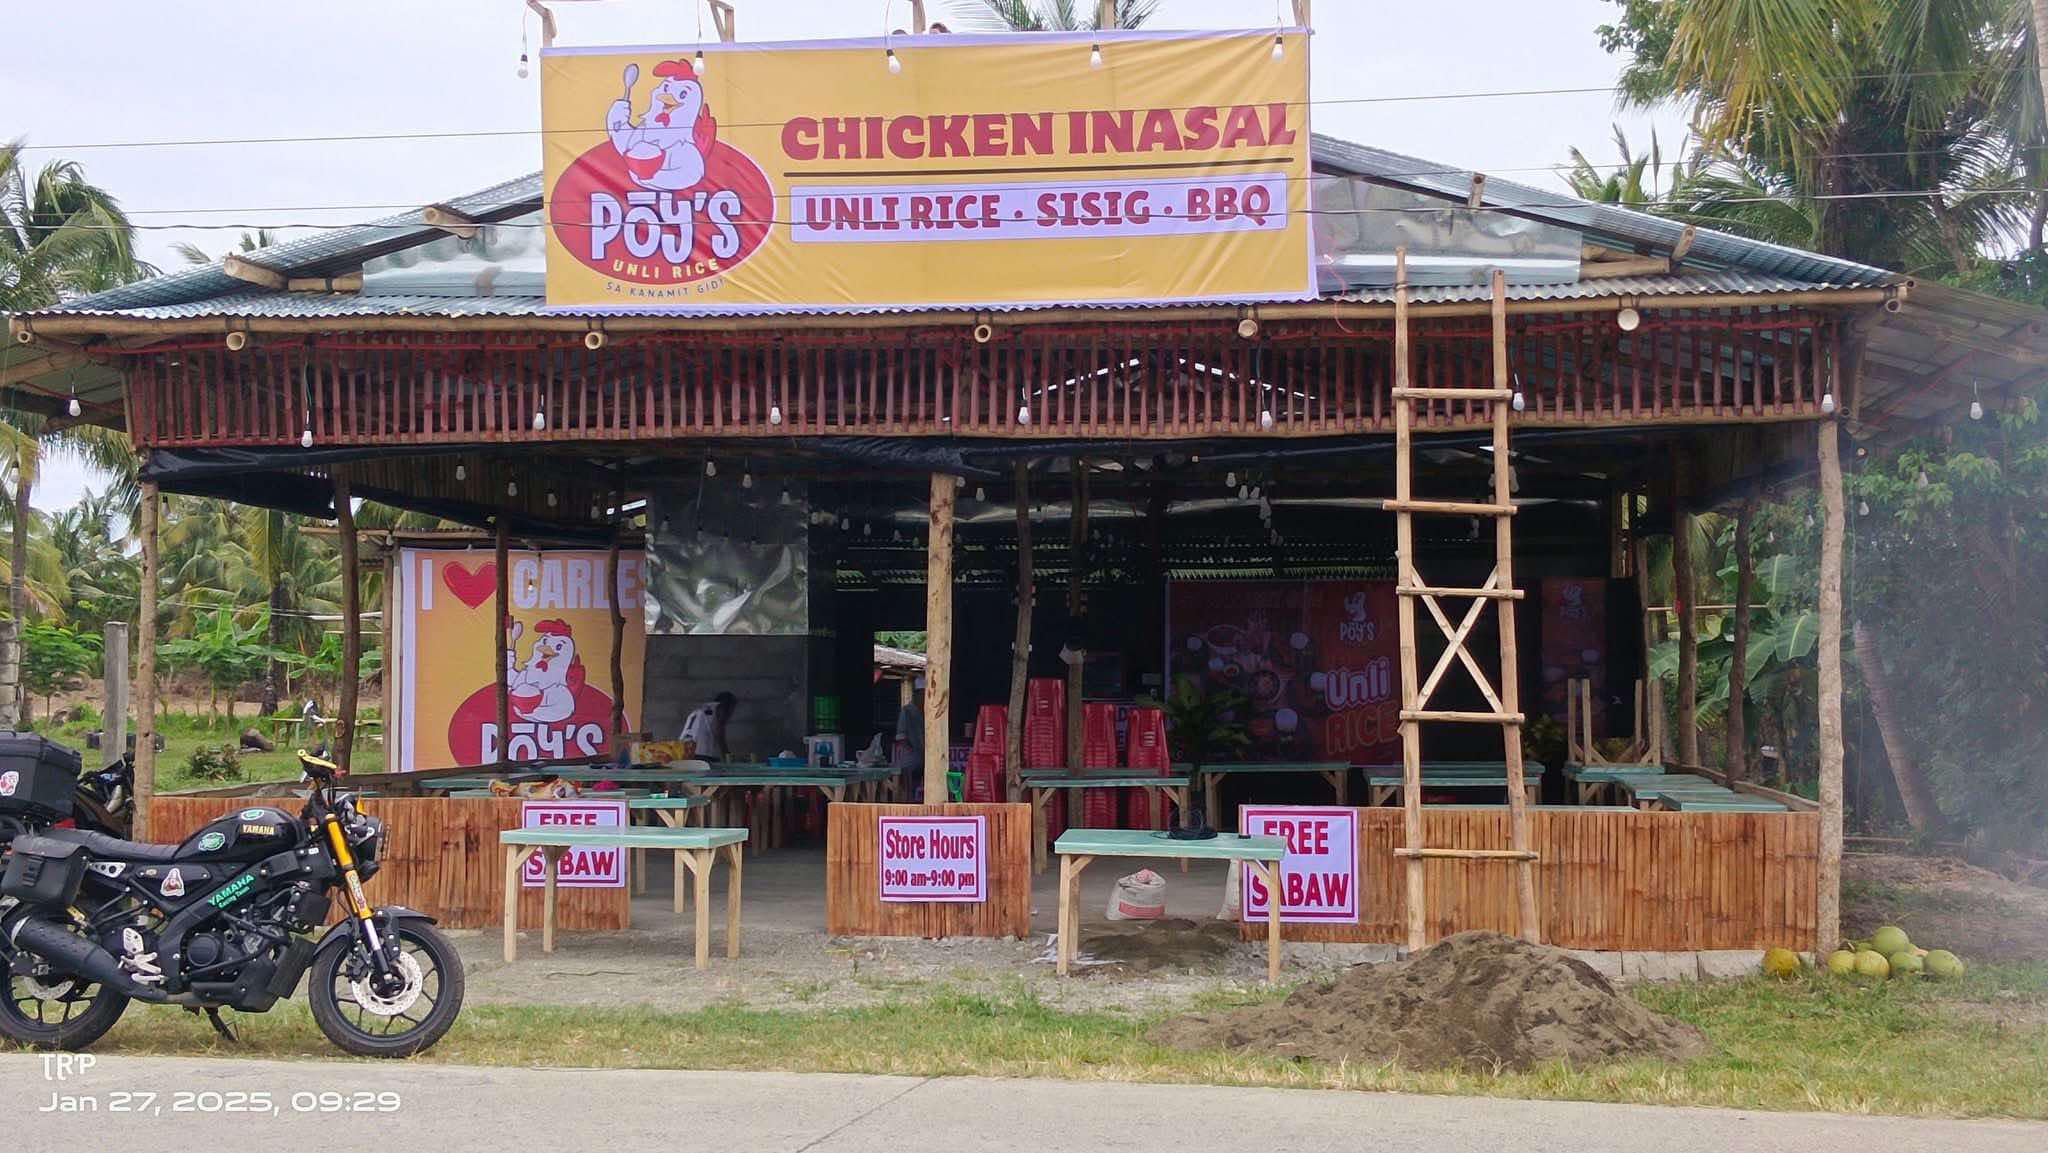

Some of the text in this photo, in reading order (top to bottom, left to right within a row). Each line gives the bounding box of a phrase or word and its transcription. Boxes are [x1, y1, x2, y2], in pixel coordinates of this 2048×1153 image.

[781, 102, 1297, 161] CHICKEN INASAL
[806, 184, 1272, 231] UNLI RICE SISIG BBQ
[612, 257, 720, 279] UNLI RICE
[605, 281, 621, 293] SA
[421, 559, 433, 610] I
[242, 824, 275, 835] YAMAHA
[885, 829, 975, 859] Store Hours
[528, 850, 615, 876] SBAW
[208, 874, 255, 906] YAMAHA
[885, 869, 975, 890] 9:00 am-9:00 pm
